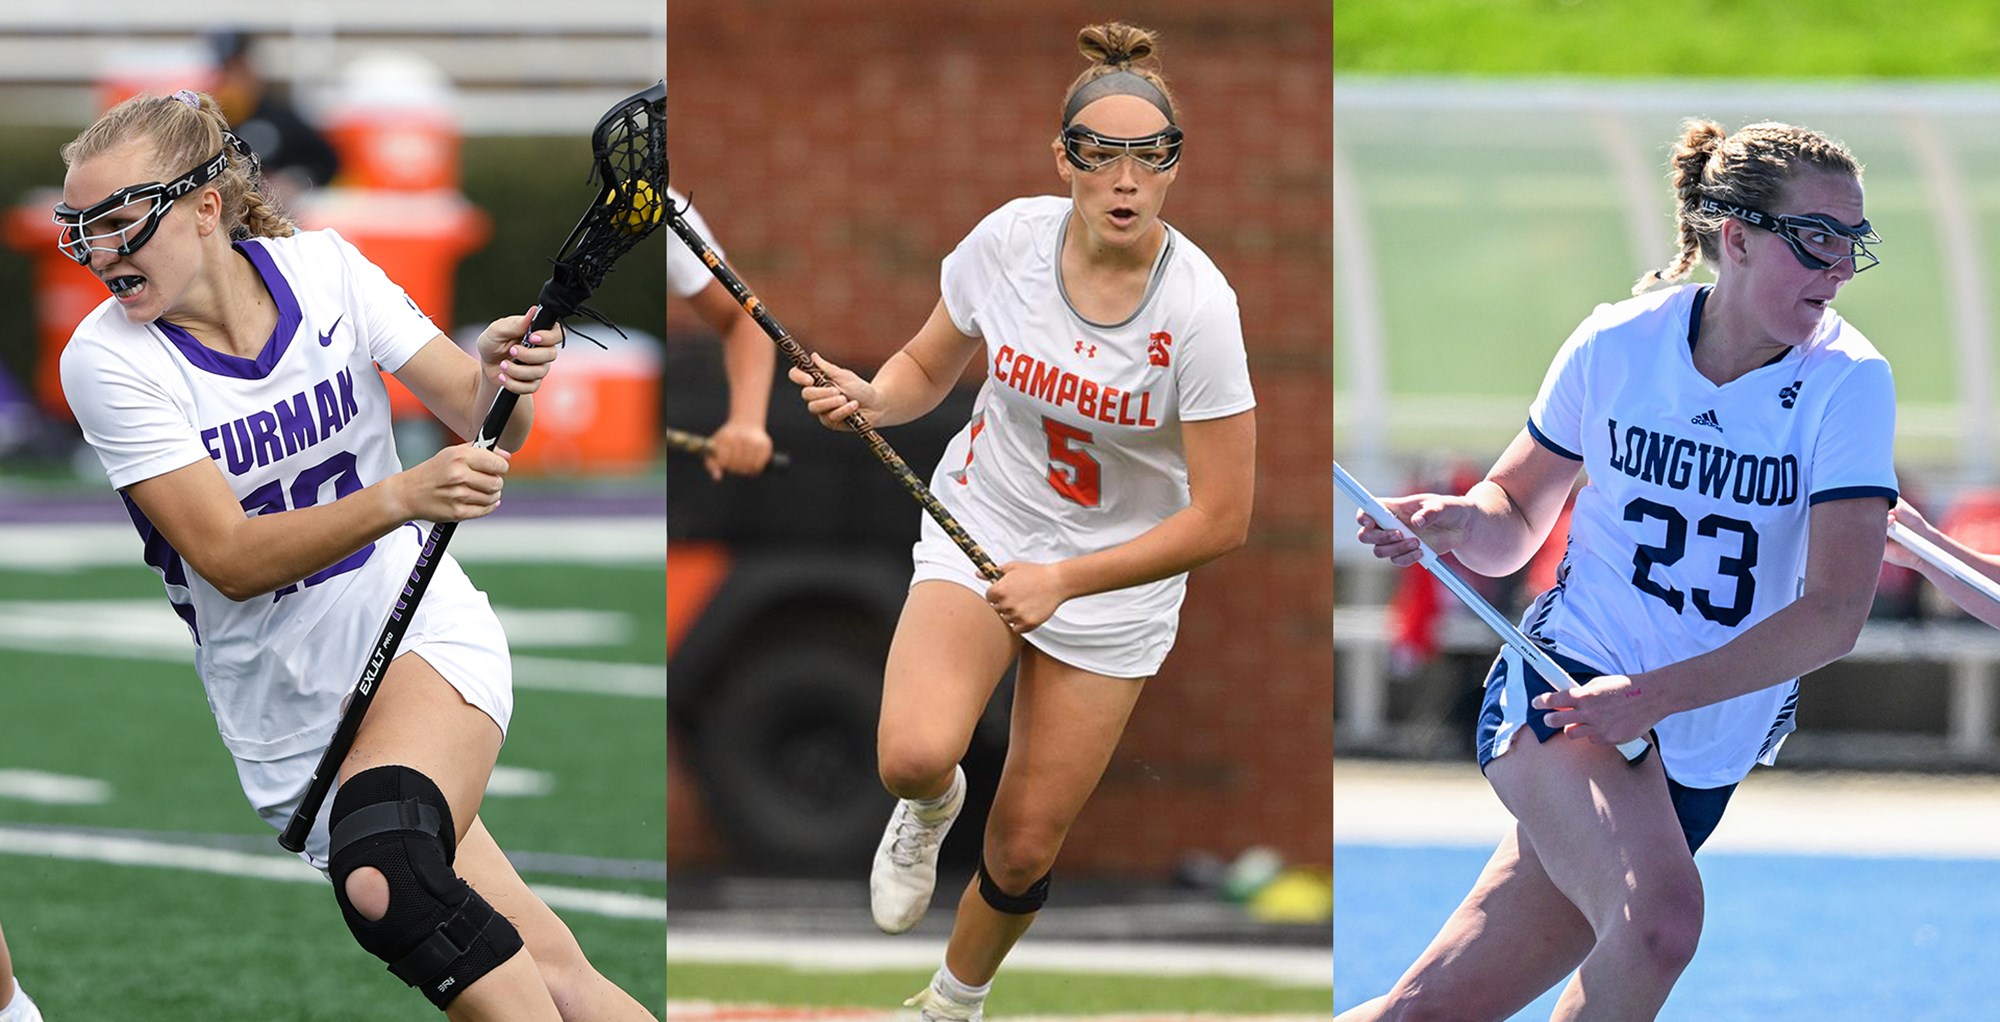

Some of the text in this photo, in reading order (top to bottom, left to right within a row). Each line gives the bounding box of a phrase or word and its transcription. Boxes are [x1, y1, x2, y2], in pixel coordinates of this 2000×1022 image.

[221, 131, 241, 150] TX
[994, 344, 1157, 427] CAMPBELL
[1041, 414, 1102, 509] 5
[1608, 418, 1798, 506] LONGWOOD
[1624, 497, 1759, 627] 23
[359, 631, 394, 696] EXULT PRO
